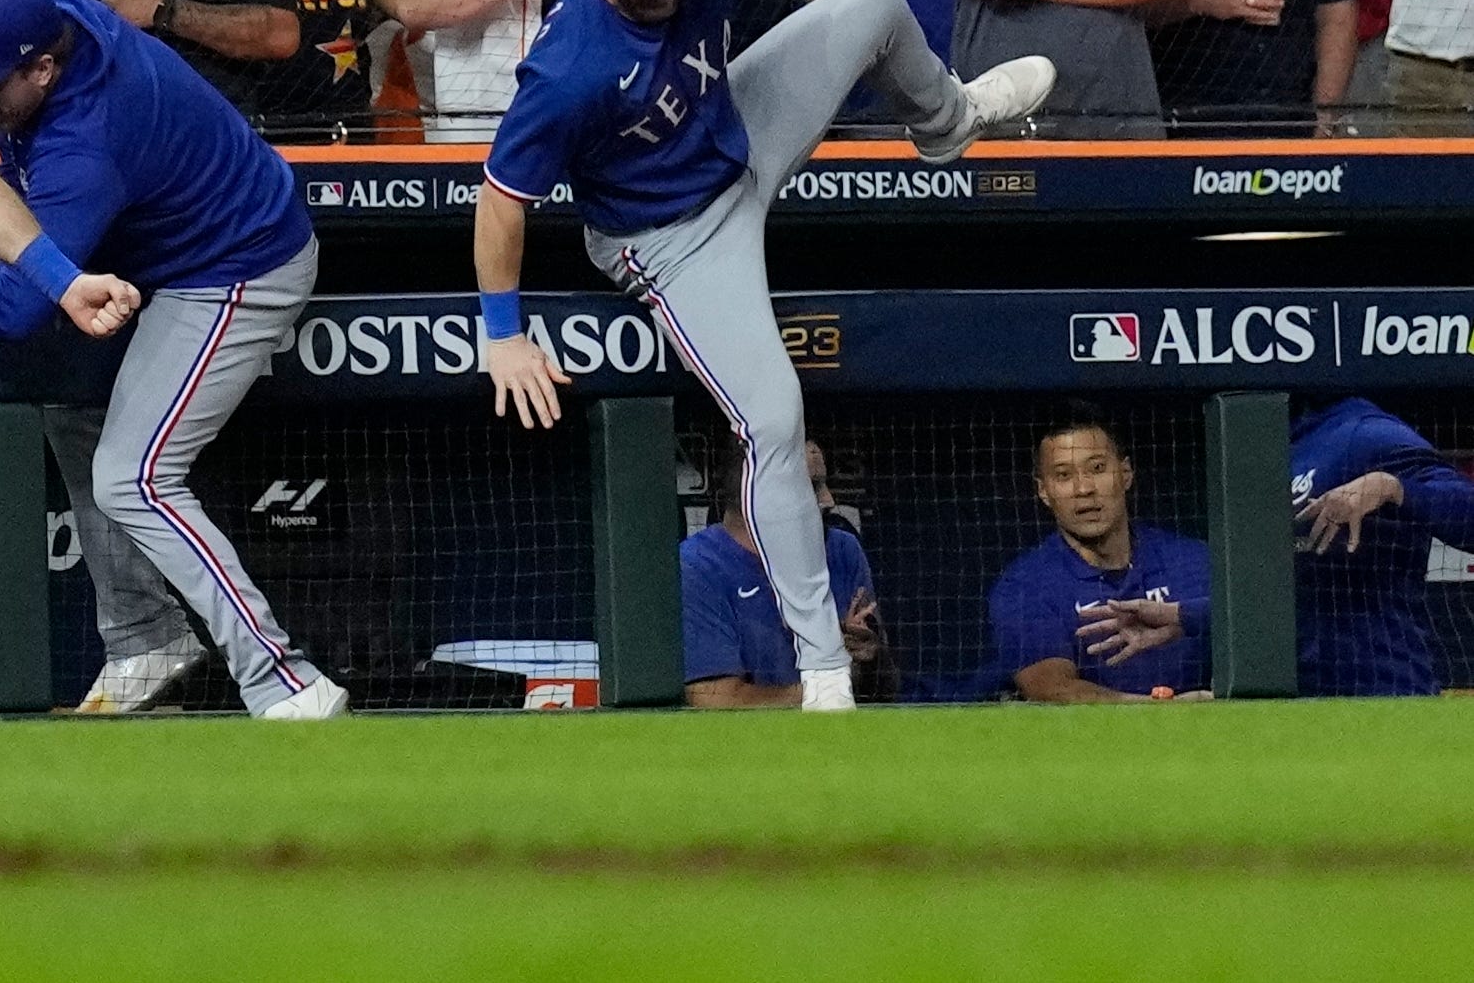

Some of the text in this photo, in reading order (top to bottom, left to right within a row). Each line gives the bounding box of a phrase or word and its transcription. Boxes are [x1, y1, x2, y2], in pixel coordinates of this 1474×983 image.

[620, 19, 731, 144] TEX
[348, 180, 426, 208] ALCS
[1194, 165, 1344, 200] loanDepot
[1151, 304, 1474, 366] ALCS loan
